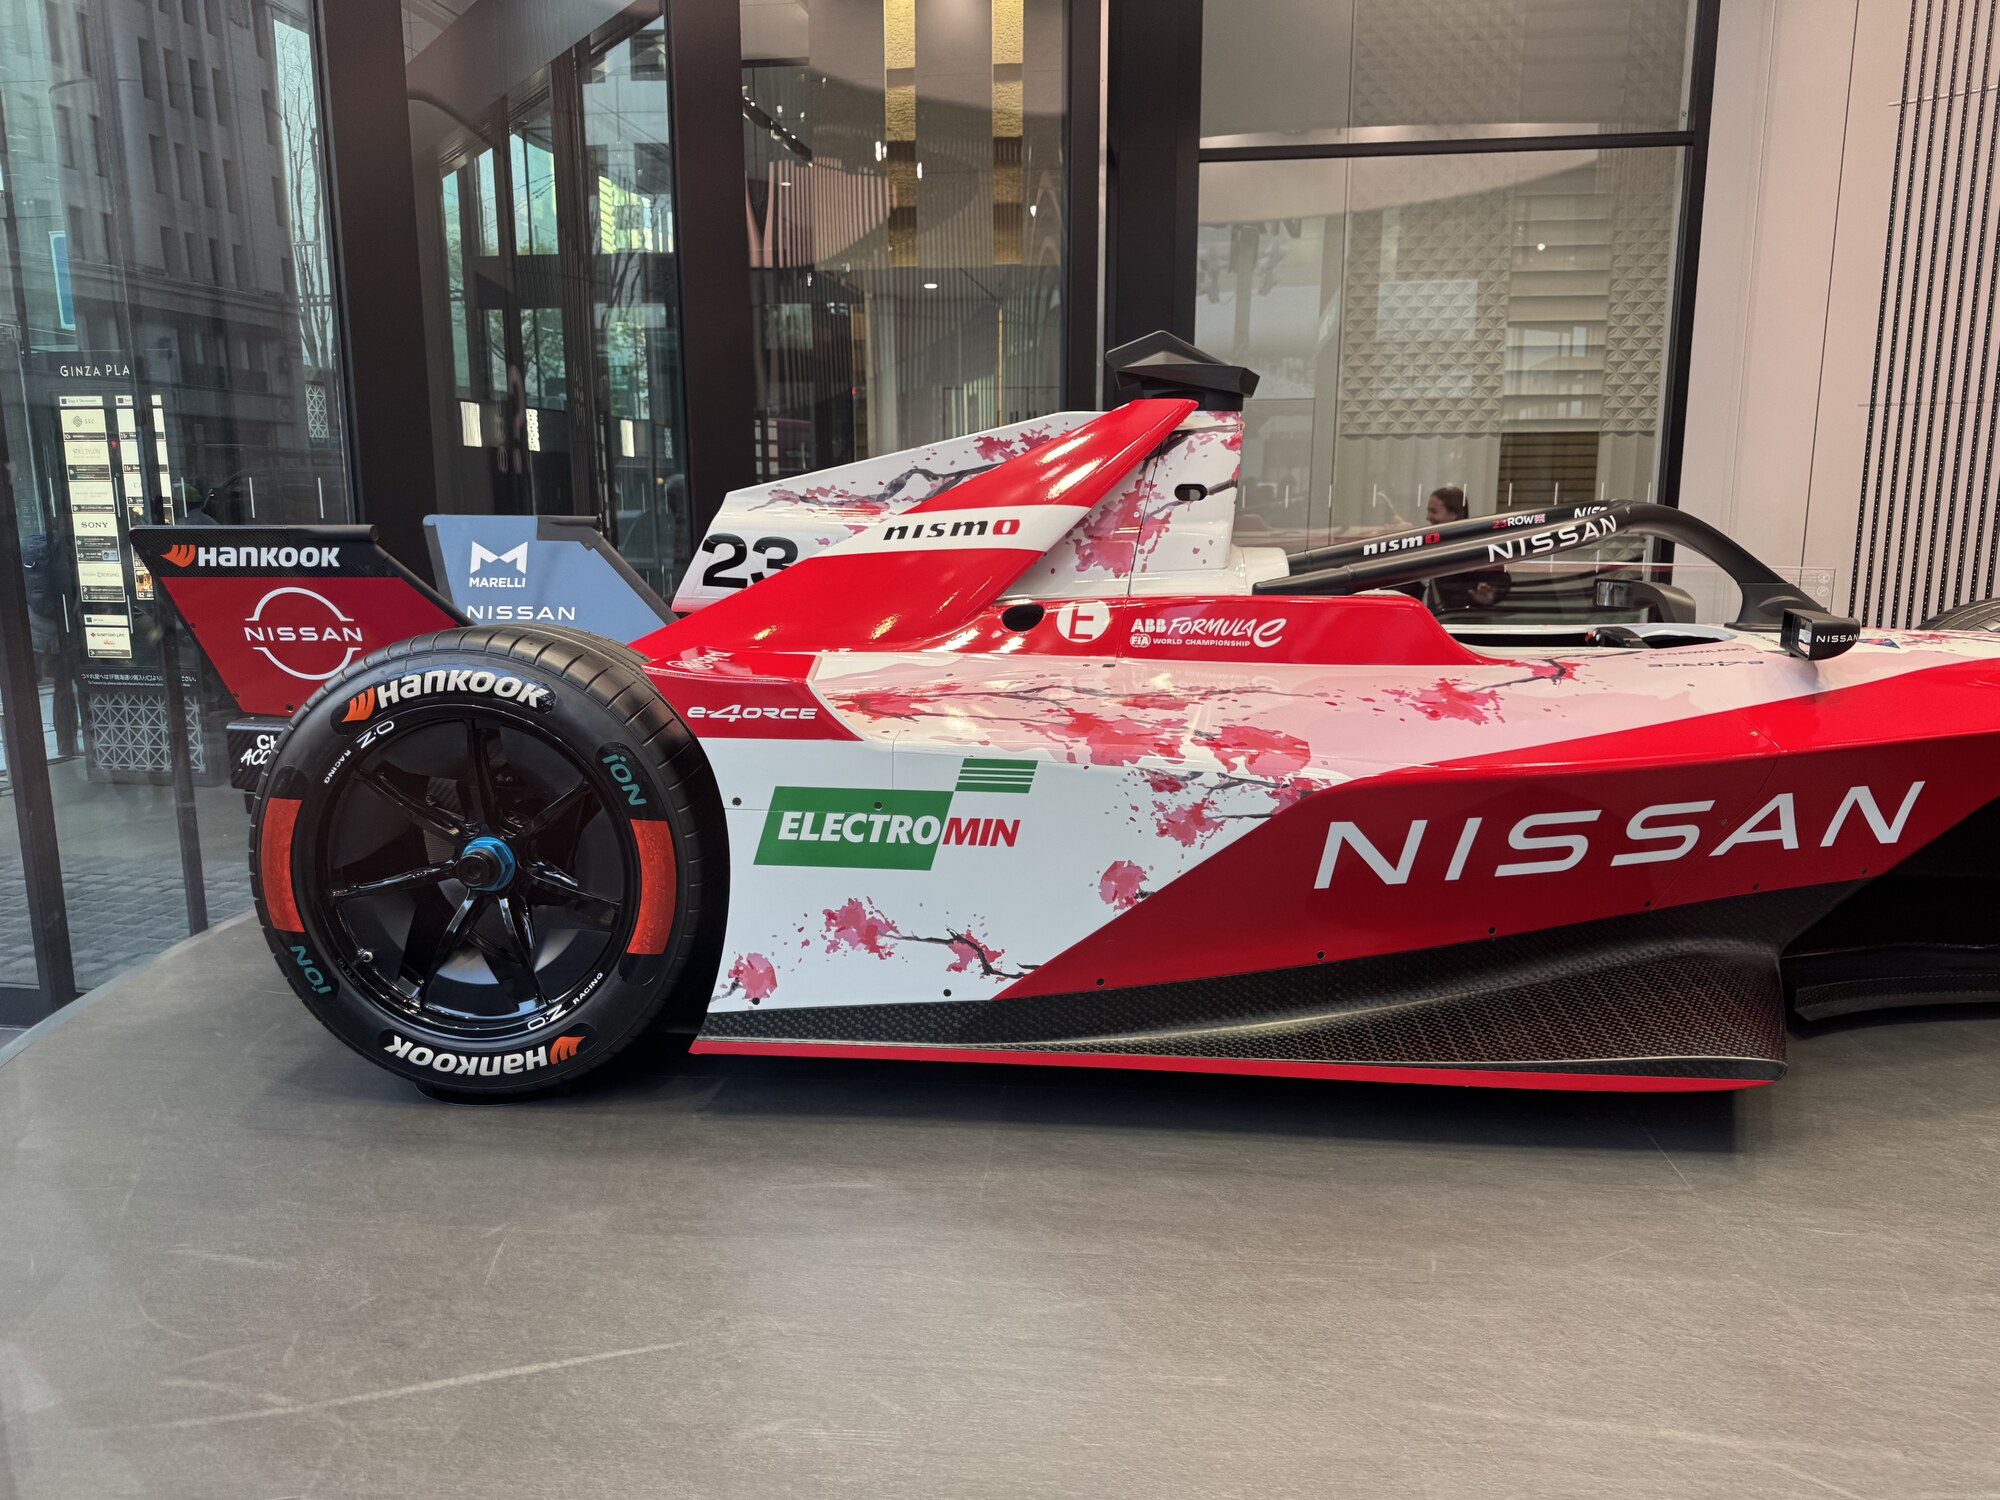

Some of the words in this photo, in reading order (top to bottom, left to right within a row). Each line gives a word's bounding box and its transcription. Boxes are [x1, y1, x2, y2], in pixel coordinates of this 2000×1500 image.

[60, 364, 101, 377] GINZA
[81, 521, 108, 529] SONY
[1488, 515, 1617, 563] NISSAN
[701, 533, 799, 589] 23
[469, 577, 526, 588] MARELLI
[466, 605, 576, 621] NISSAN
[244, 626, 363, 642] NISSAN
[1130, 618, 1166, 633] ABB
[1167, 617, 1255, 637] FORMULA
[1130, 635, 1150, 647] FIA
[1185, 639, 1251, 647] CHAMPIONSHIP
[1816, 633, 1859, 644] NISSAN
[324, 749, 351, 784] RACING
[778, 811, 1020, 847] ELECTROMIN
[1314, 780, 1925, 889] NISSAN
[572, 972, 604, 1005] RACING
